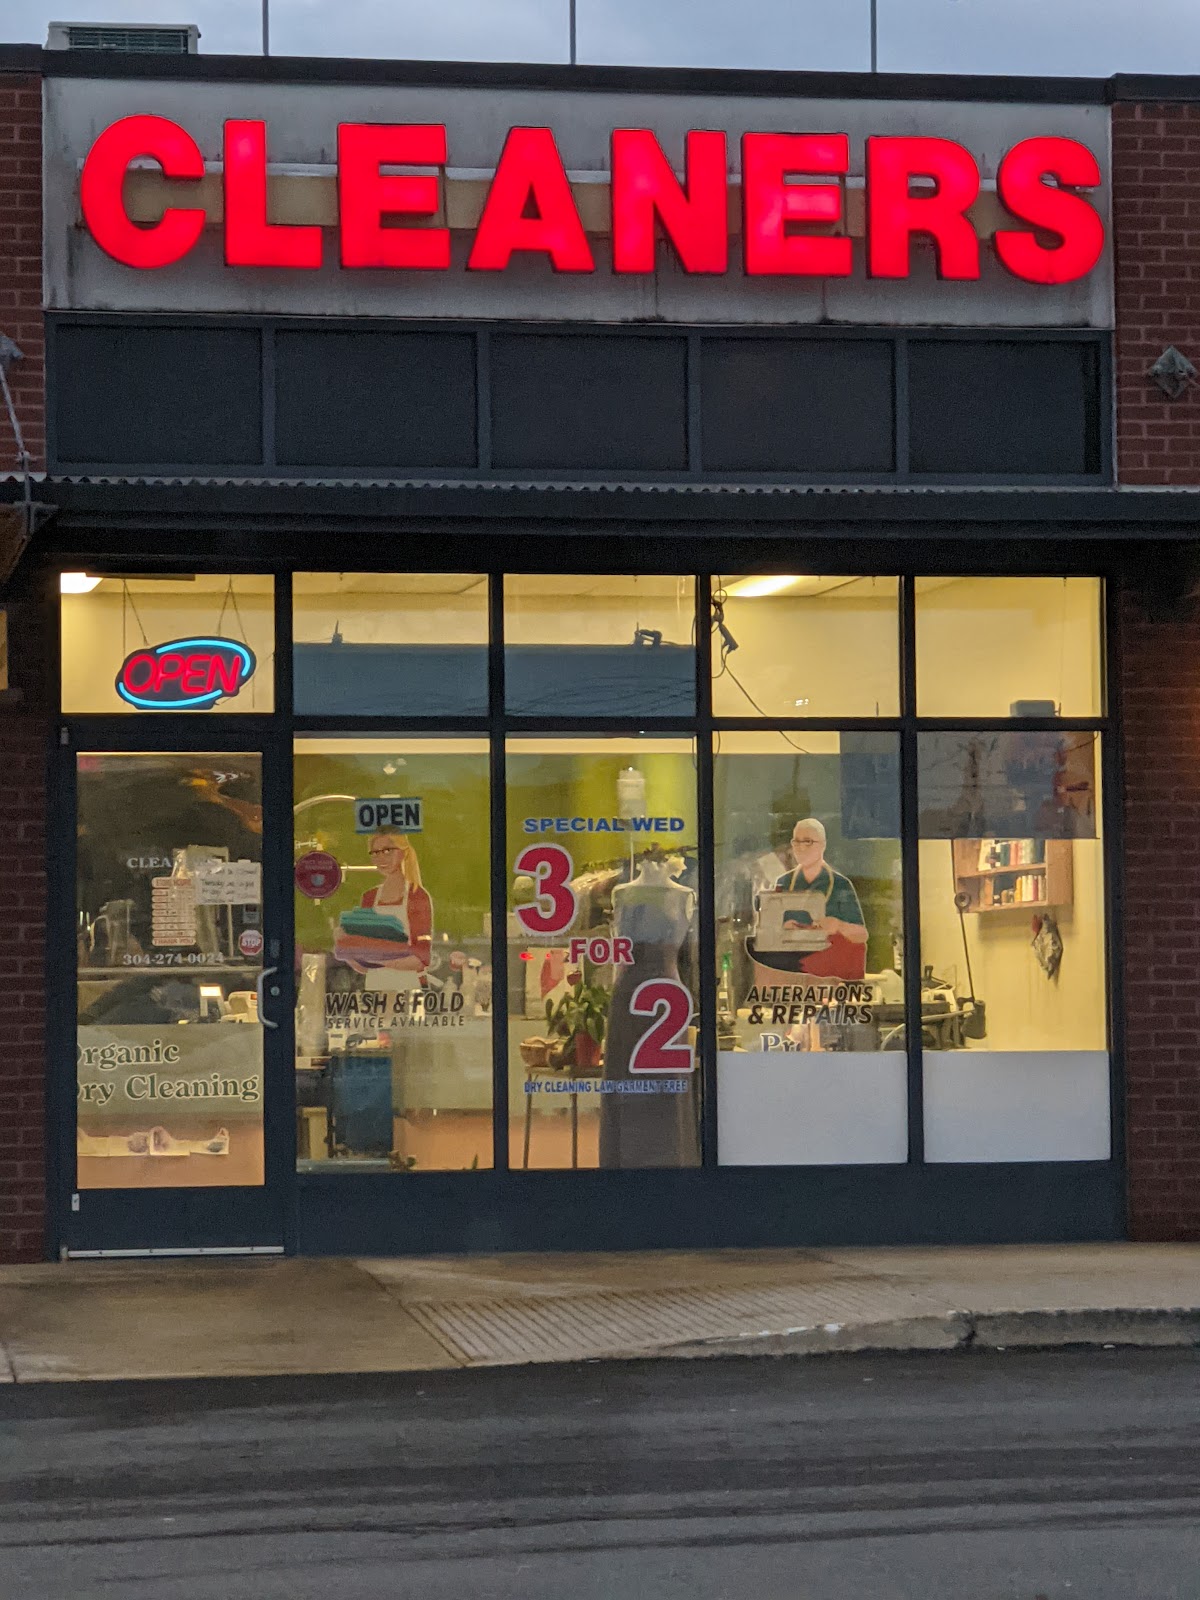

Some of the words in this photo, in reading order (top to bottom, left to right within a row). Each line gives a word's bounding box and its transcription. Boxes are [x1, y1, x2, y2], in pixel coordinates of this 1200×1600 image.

[79, 113, 1105, 284] CLEANERS
[123, 653, 242, 694] OPEN
[358, 803, 421, 828] OPEN
[523, 817, 624, 833] SPECIAL
[631, 817, 685, 833] WED
[514, 842, 578, 937] 3
[568, 936, 635, 966] FOR
[326, 991, 390, 1014] WASH
[392, 991, 406, 1014] &
[411, 991, 465, 1014] FOLD
[747, 984, 874, 1003] ALTERATIONS
[327, 1015, 384, 1029] SERVICE
[390, 1015, 466, 1028] AVAILABLE
[628, 977, 695, 1074] 2
[747, 1004, 764, 1025] &
[771, 1004, 874, 1025] REPAIRS
[125, 1073, 260, 1102] Cleaning
[523, 1080, 543, 1094] DRY
[544, 1080, 592, 1094] CLEANING
